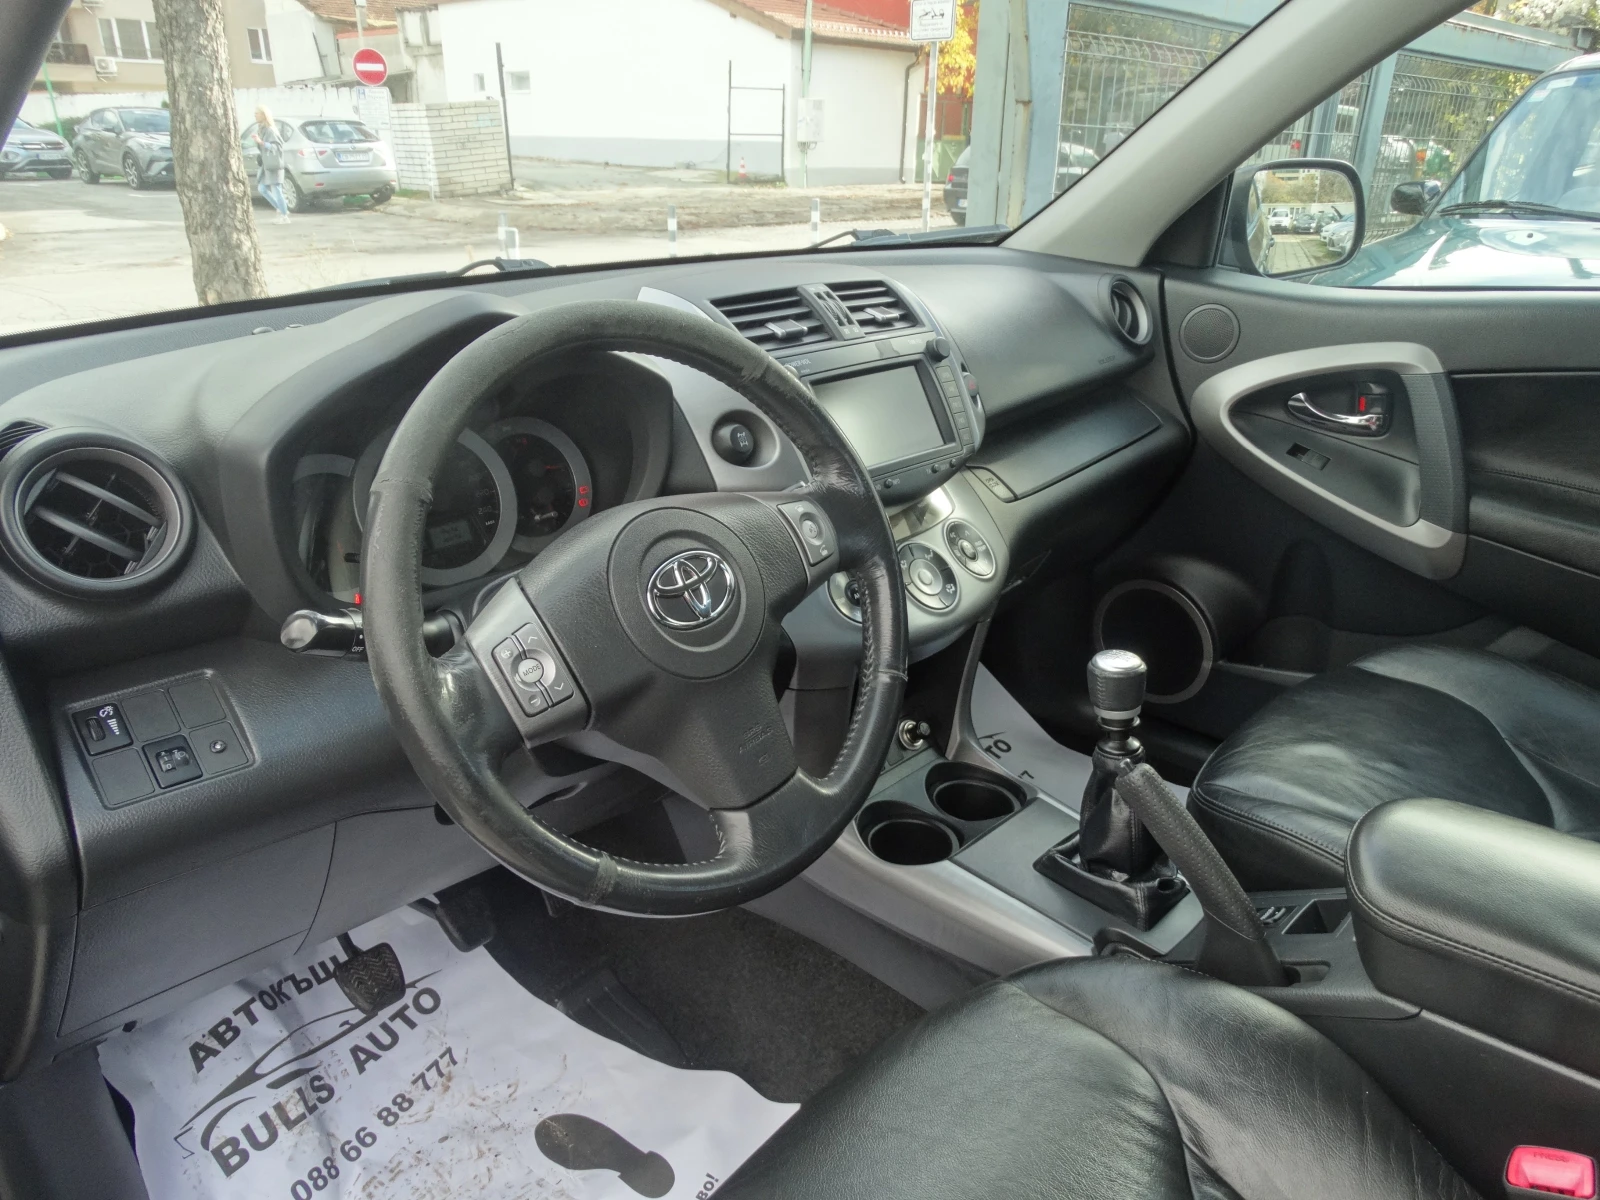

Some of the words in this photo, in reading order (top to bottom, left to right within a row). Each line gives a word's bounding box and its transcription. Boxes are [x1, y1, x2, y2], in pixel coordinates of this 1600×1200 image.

[522, 663, 541, 677] MODE
[984, 739, 1012, 760] TO
[210, 1074, 335, 1179] BULLS
[349, 987, 441, 1076] AUTO
[290, 1156, 340, 1200] 088
[340, 1126, 377, 1162] 66
[377, 1093, 414, 1127] 88
[411, 1046, 458, 1091] 777
